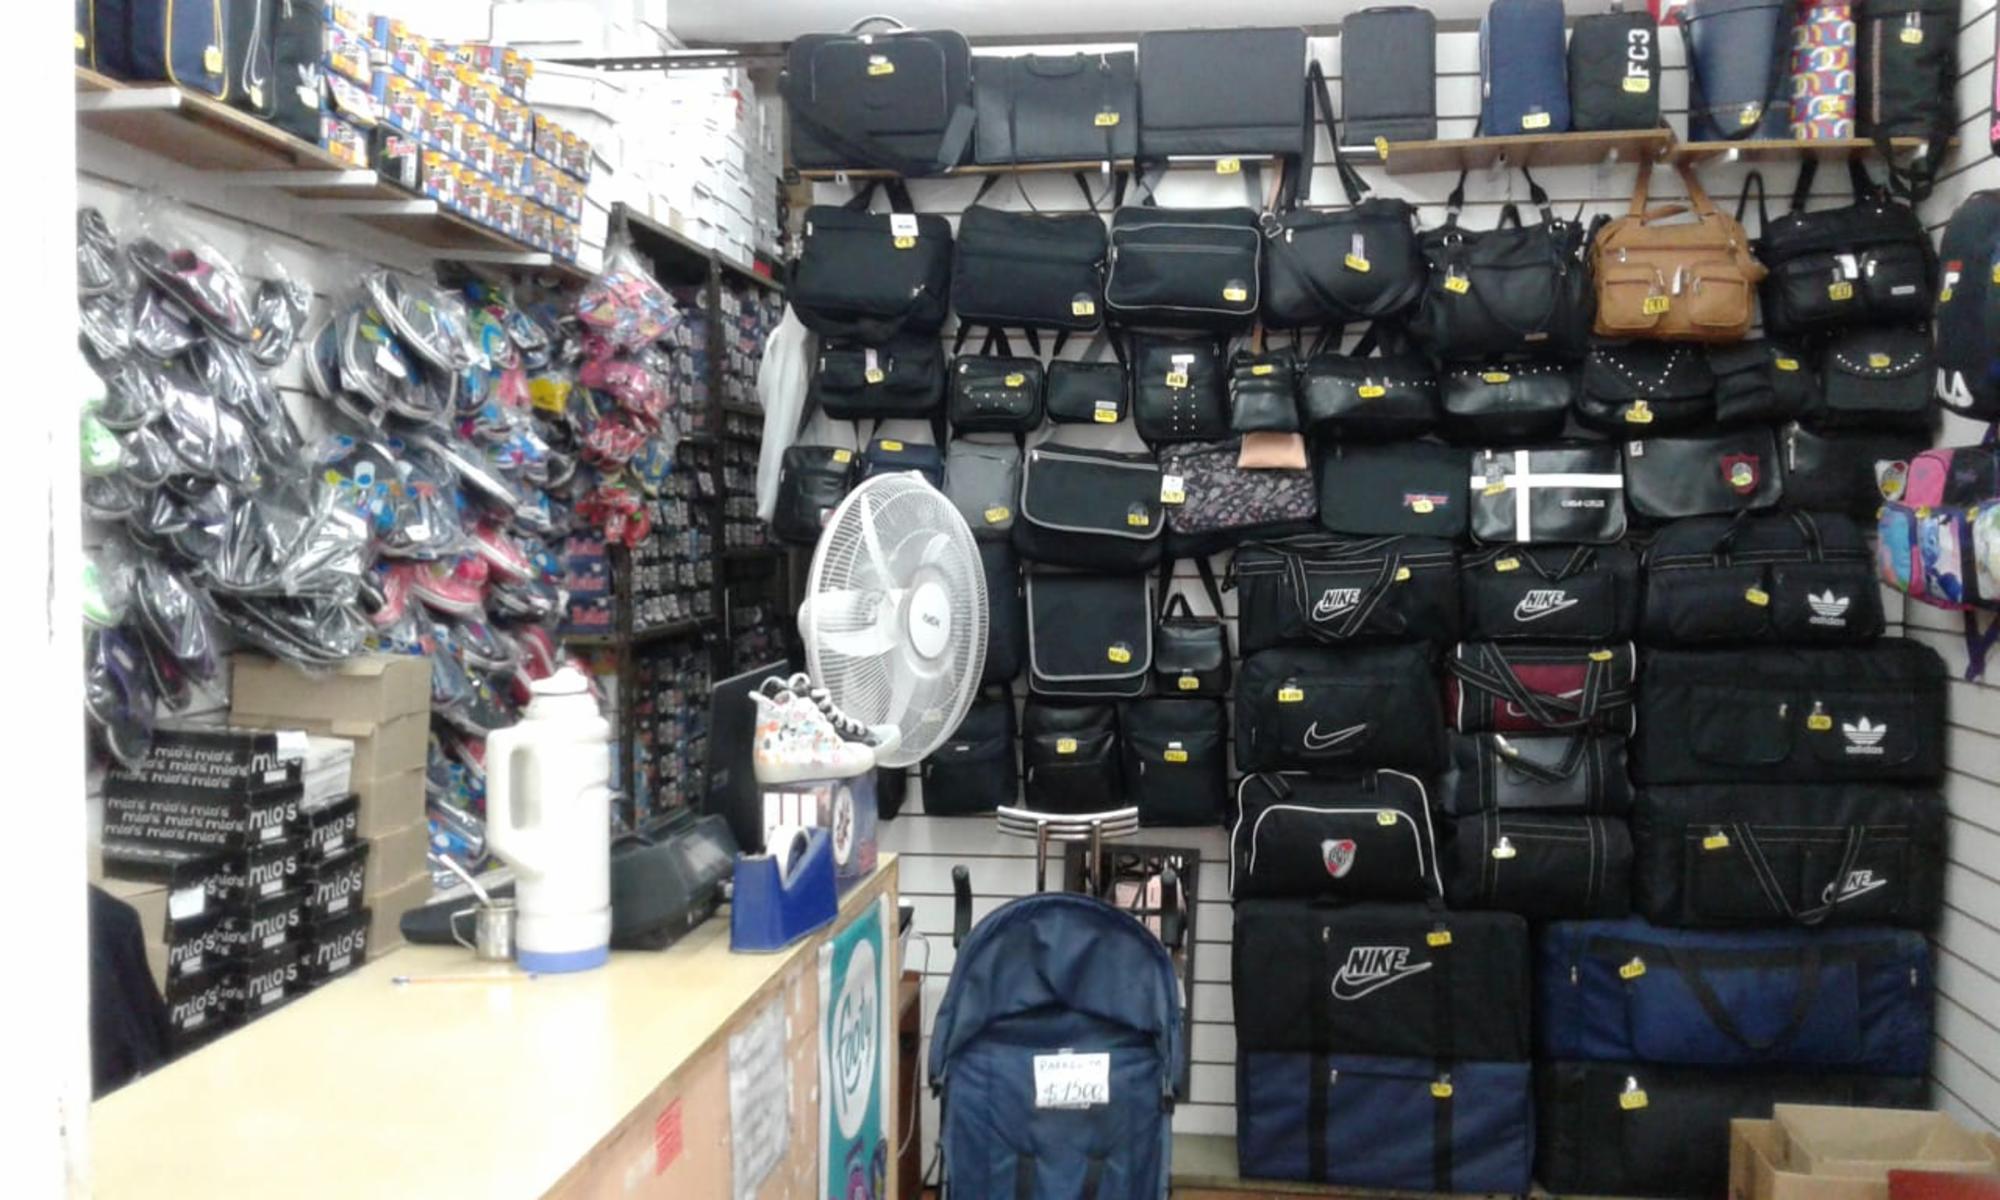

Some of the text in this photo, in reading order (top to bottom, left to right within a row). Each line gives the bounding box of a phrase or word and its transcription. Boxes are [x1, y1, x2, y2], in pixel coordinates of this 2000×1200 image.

[1321, 587, 1361, 608] NIKE
[1521, 590, 1565, 610] NIKE
[1344, 946, 1410, 978] NIKE
